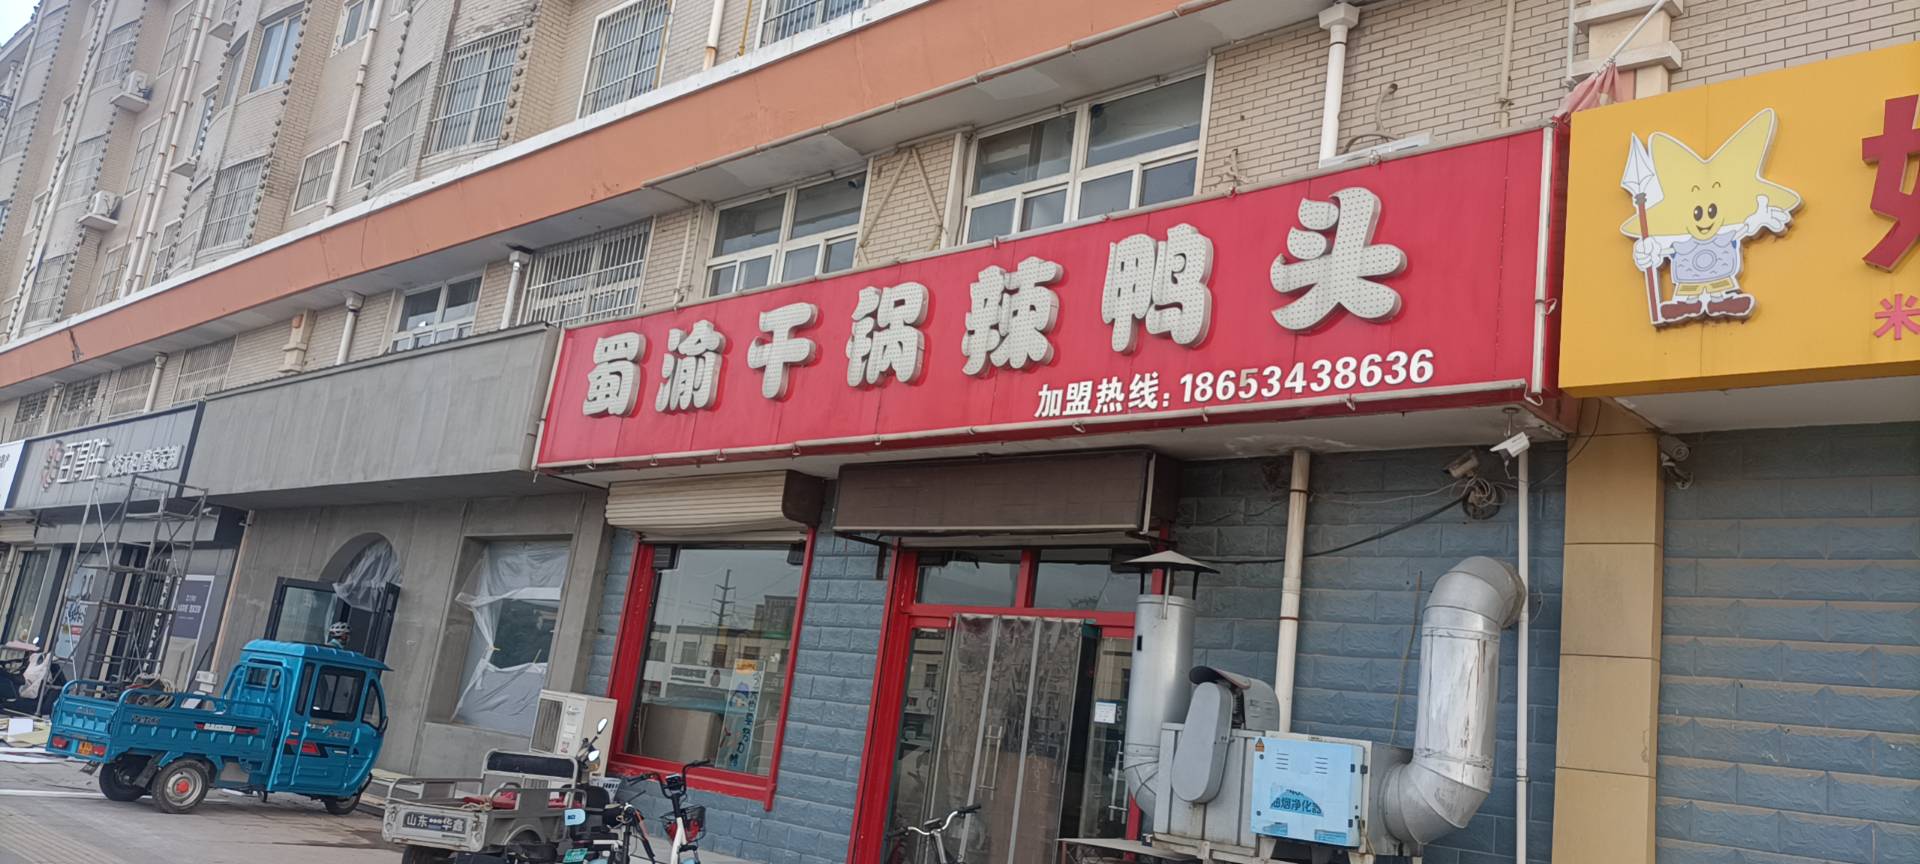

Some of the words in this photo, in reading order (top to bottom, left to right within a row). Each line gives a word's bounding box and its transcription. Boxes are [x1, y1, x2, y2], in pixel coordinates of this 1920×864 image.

[582, 187, 1407, 417] 蜀渝干锅辣鸭头
[1180, 349, 1434, 403] 18653438636
[406, 813, 428, 828] 山东
